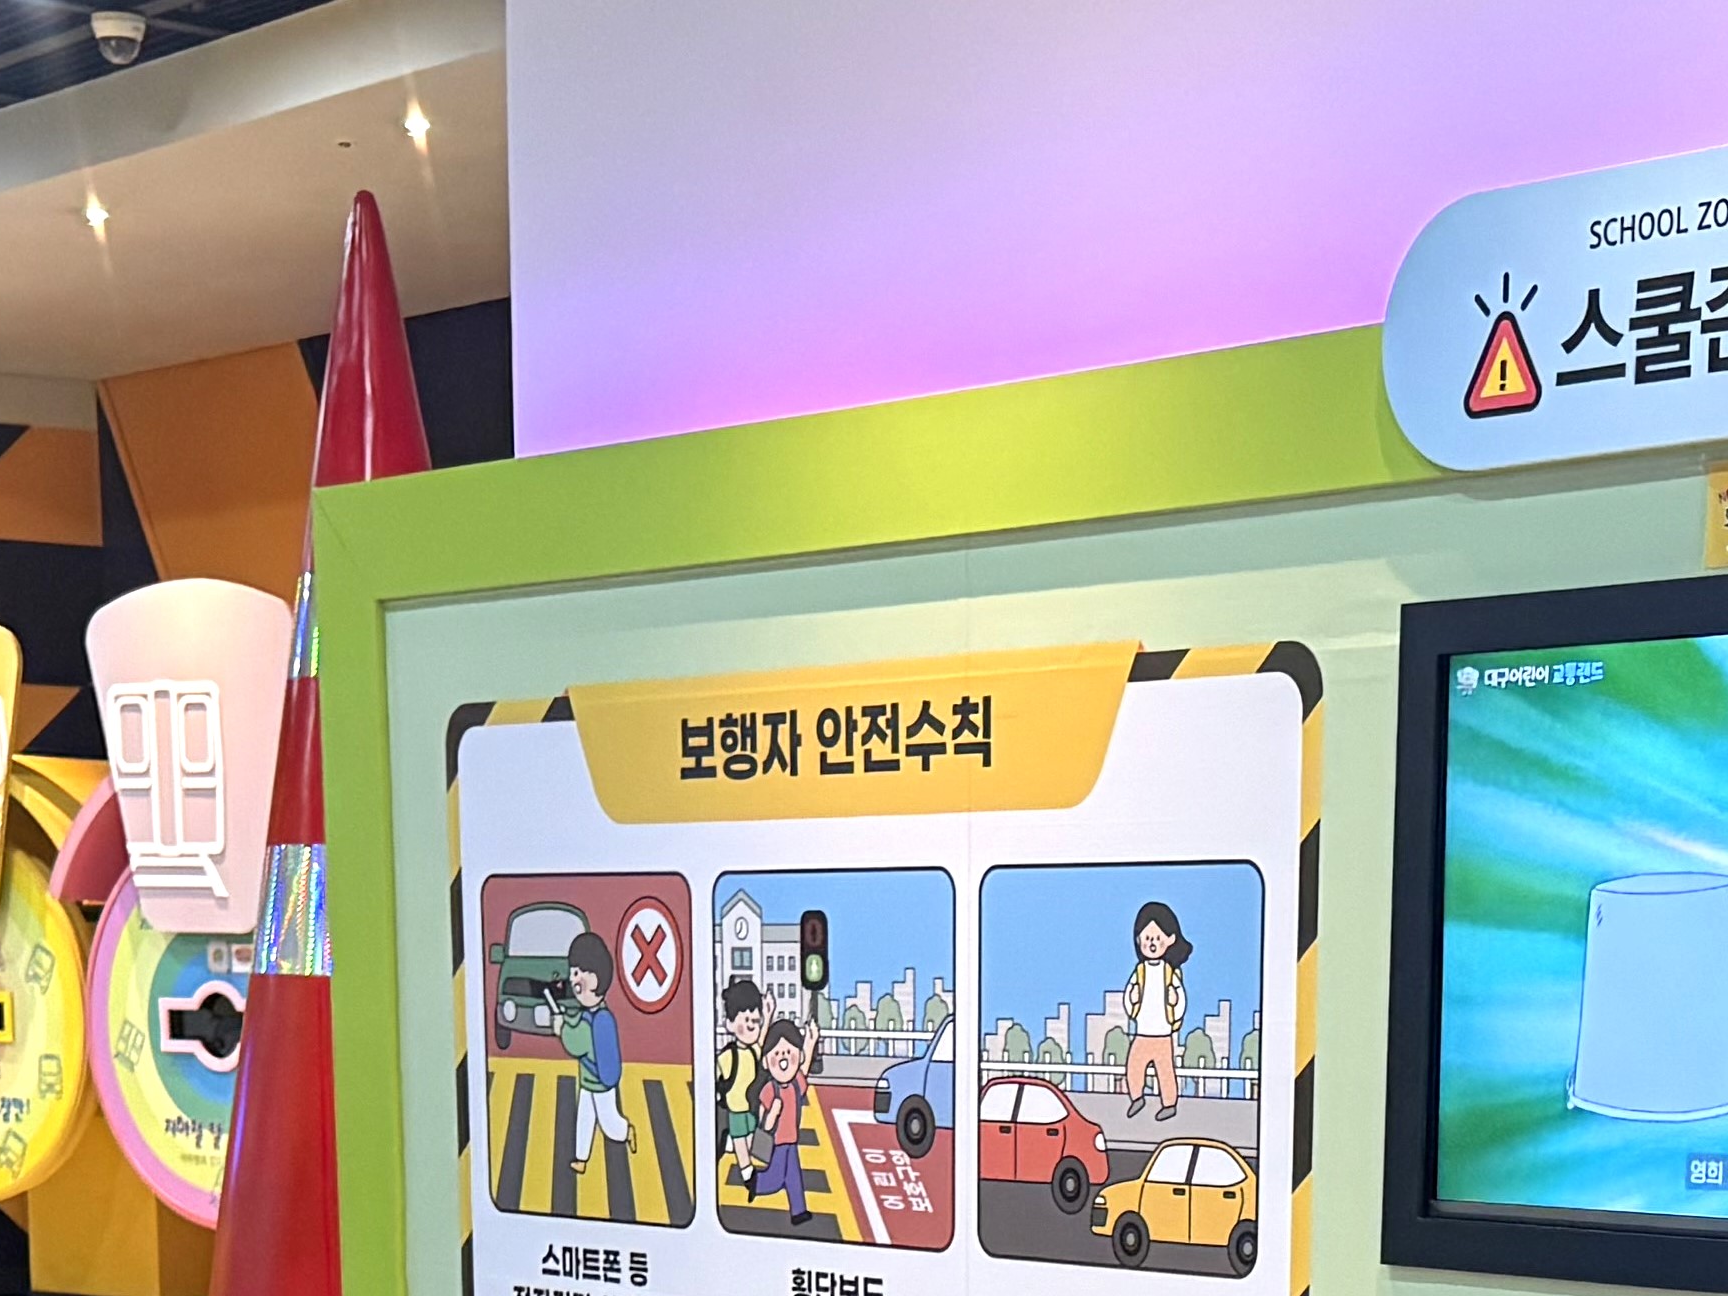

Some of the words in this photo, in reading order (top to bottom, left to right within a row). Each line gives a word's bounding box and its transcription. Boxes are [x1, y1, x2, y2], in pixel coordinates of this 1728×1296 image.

[1589, 208, 1689, 250] SCHOOL
[1484, 665, 1550, 688] 대구어린이
[678, 708, 802, 782] 보행자
[815, 695, 994, 776] 안전수칙
[1689, 1159, 1723, 1185] 영희
[541, 1242, 623, 1285] 스마트폰
[628, 1251, 649, 1288] 등
